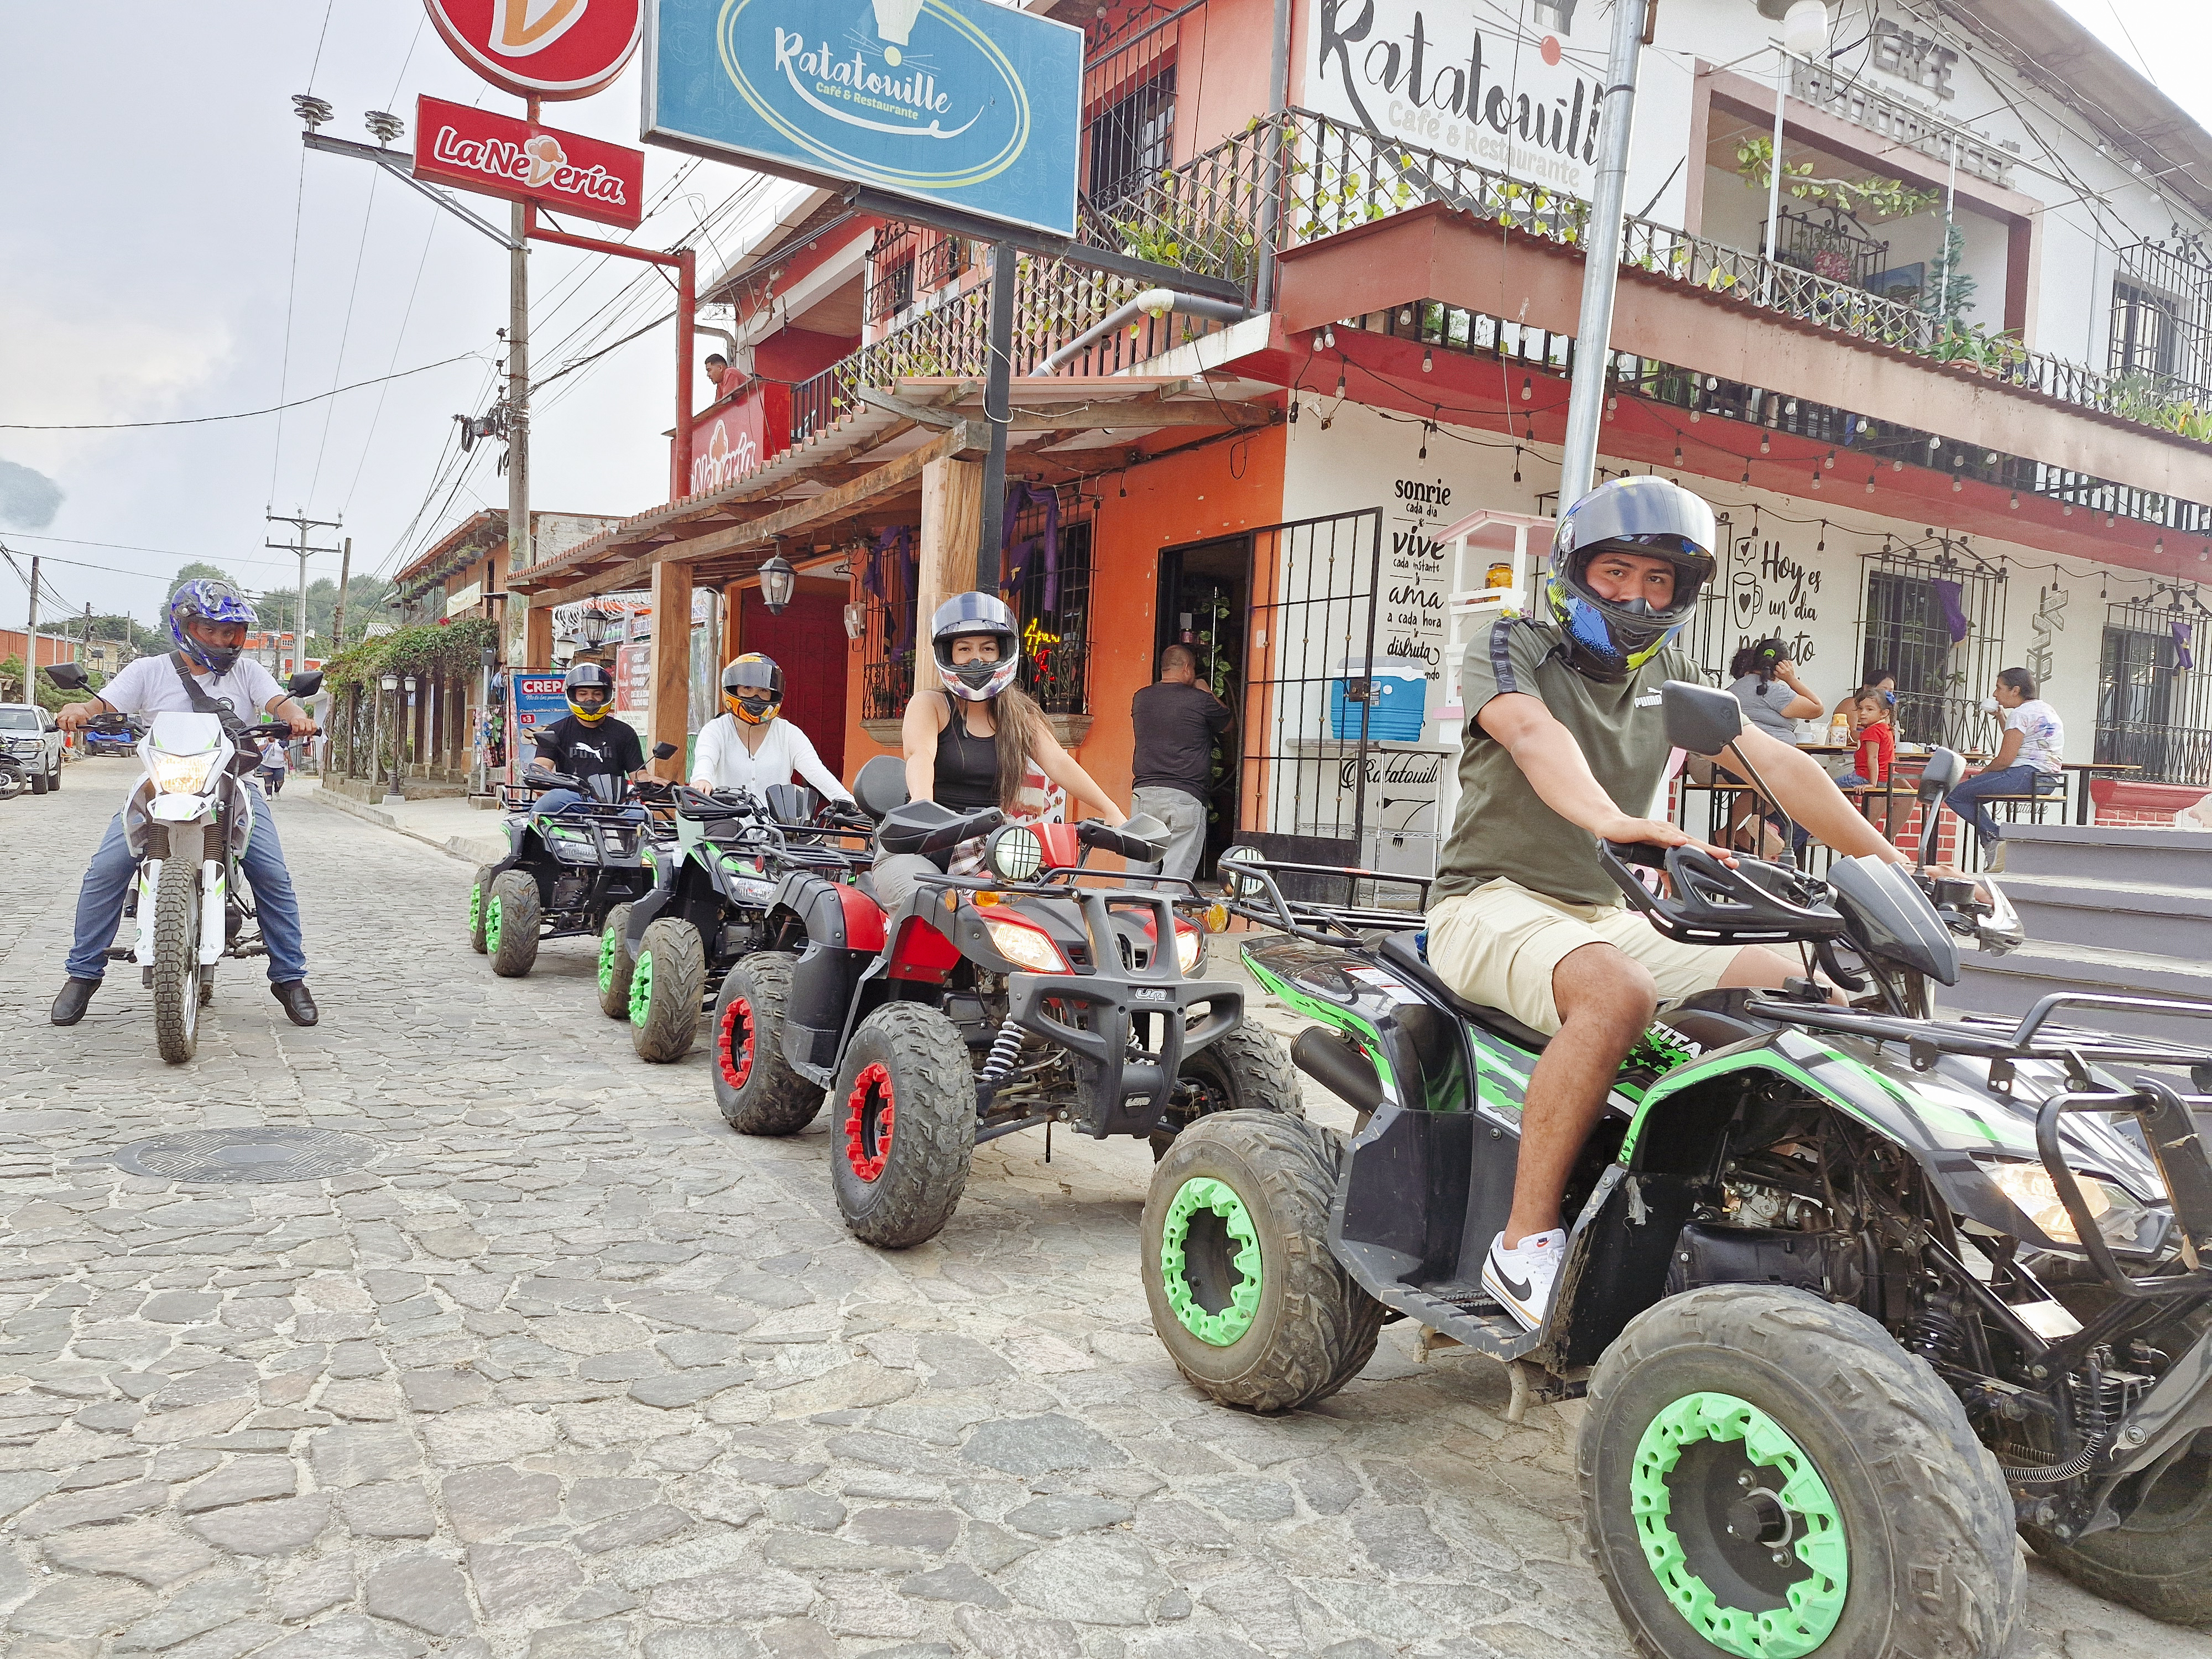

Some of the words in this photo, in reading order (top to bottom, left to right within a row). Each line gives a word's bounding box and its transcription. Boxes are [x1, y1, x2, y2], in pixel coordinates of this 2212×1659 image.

[774, 27, 952, 115] Ratatouille
[1319, 0, 1605, 166] Ratatouill
[816, 81, 841, 100] Café
[843, 89, 852, 101] &
[854, 92, 919, 121] Restaurante
[1388, 100, 1441, 140] Café
[1446, 124, 1460, 148] &
[1464, 126, 1580, 188] Restaurante
[1394, 478, 1451, 507] sonrie
[1406, 501, 1423, 515] cada
[1426, 504, 1437, 518] dia
[1393, 556, 1409, 569] cada
[1413, 559, 1440, 573] instante
[1760, 540, 1806, 605] Hoy
[1808, 570, 1822, 594] es
[1389, 585, 1444, 609] ama
[1768, 599, 1787, 620] un
[1793, 590, 1818, 621] dia
[1387, 612, 1392, 623] a
[1398, 611, 1417, 626] cada
[1422, 609, 1442, 629] hora
[1387, 635, 1441, 666] disfruta
[1634, 694, 1662, 708] PUMA
[1648, 1020, 1713, 1060] TITA
